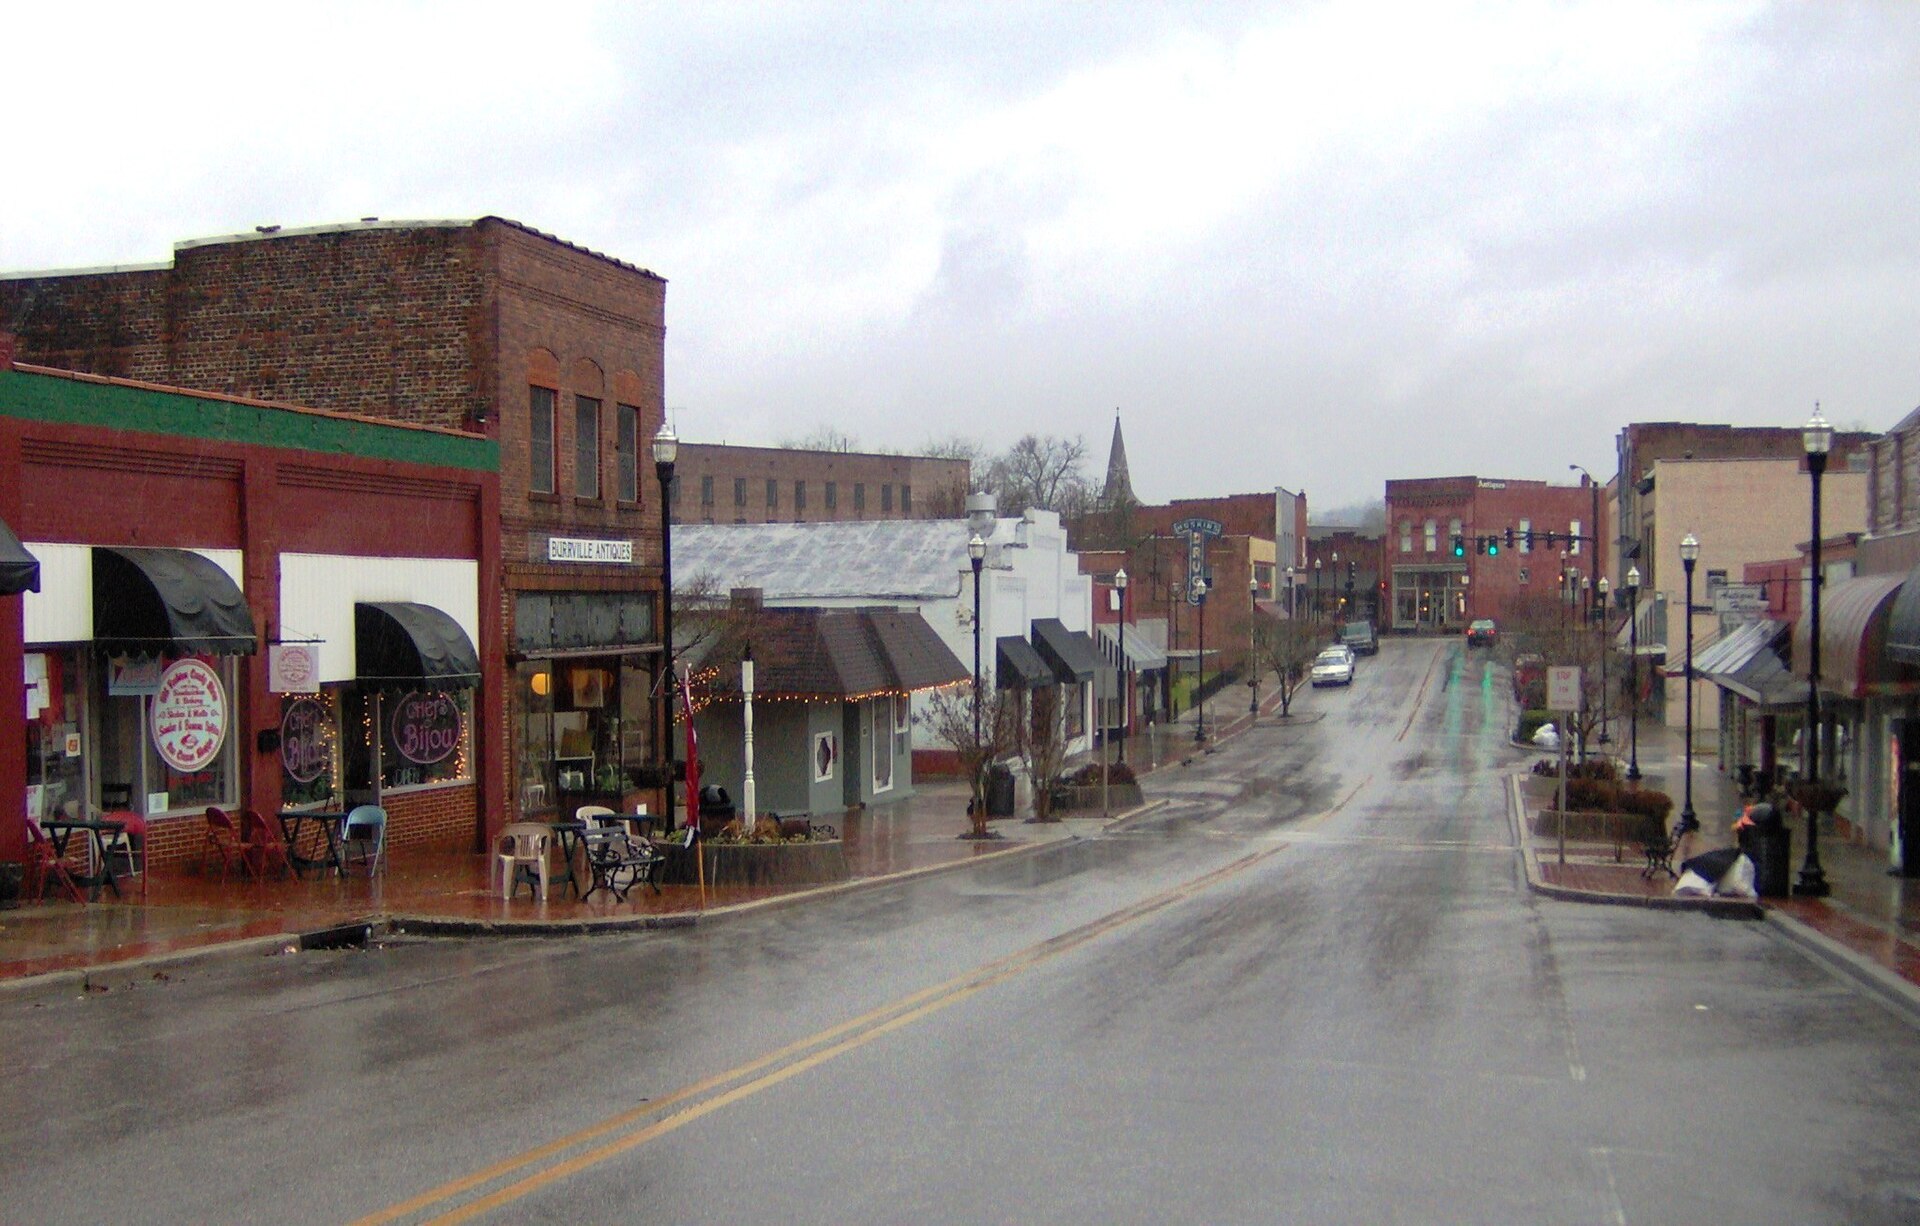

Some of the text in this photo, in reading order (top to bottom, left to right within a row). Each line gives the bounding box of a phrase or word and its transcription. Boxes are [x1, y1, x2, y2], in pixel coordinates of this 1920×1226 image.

[551, 541, 631, 560] BURRVILLE ANTIQUES
[403, 723, 455, 757] Bijou
